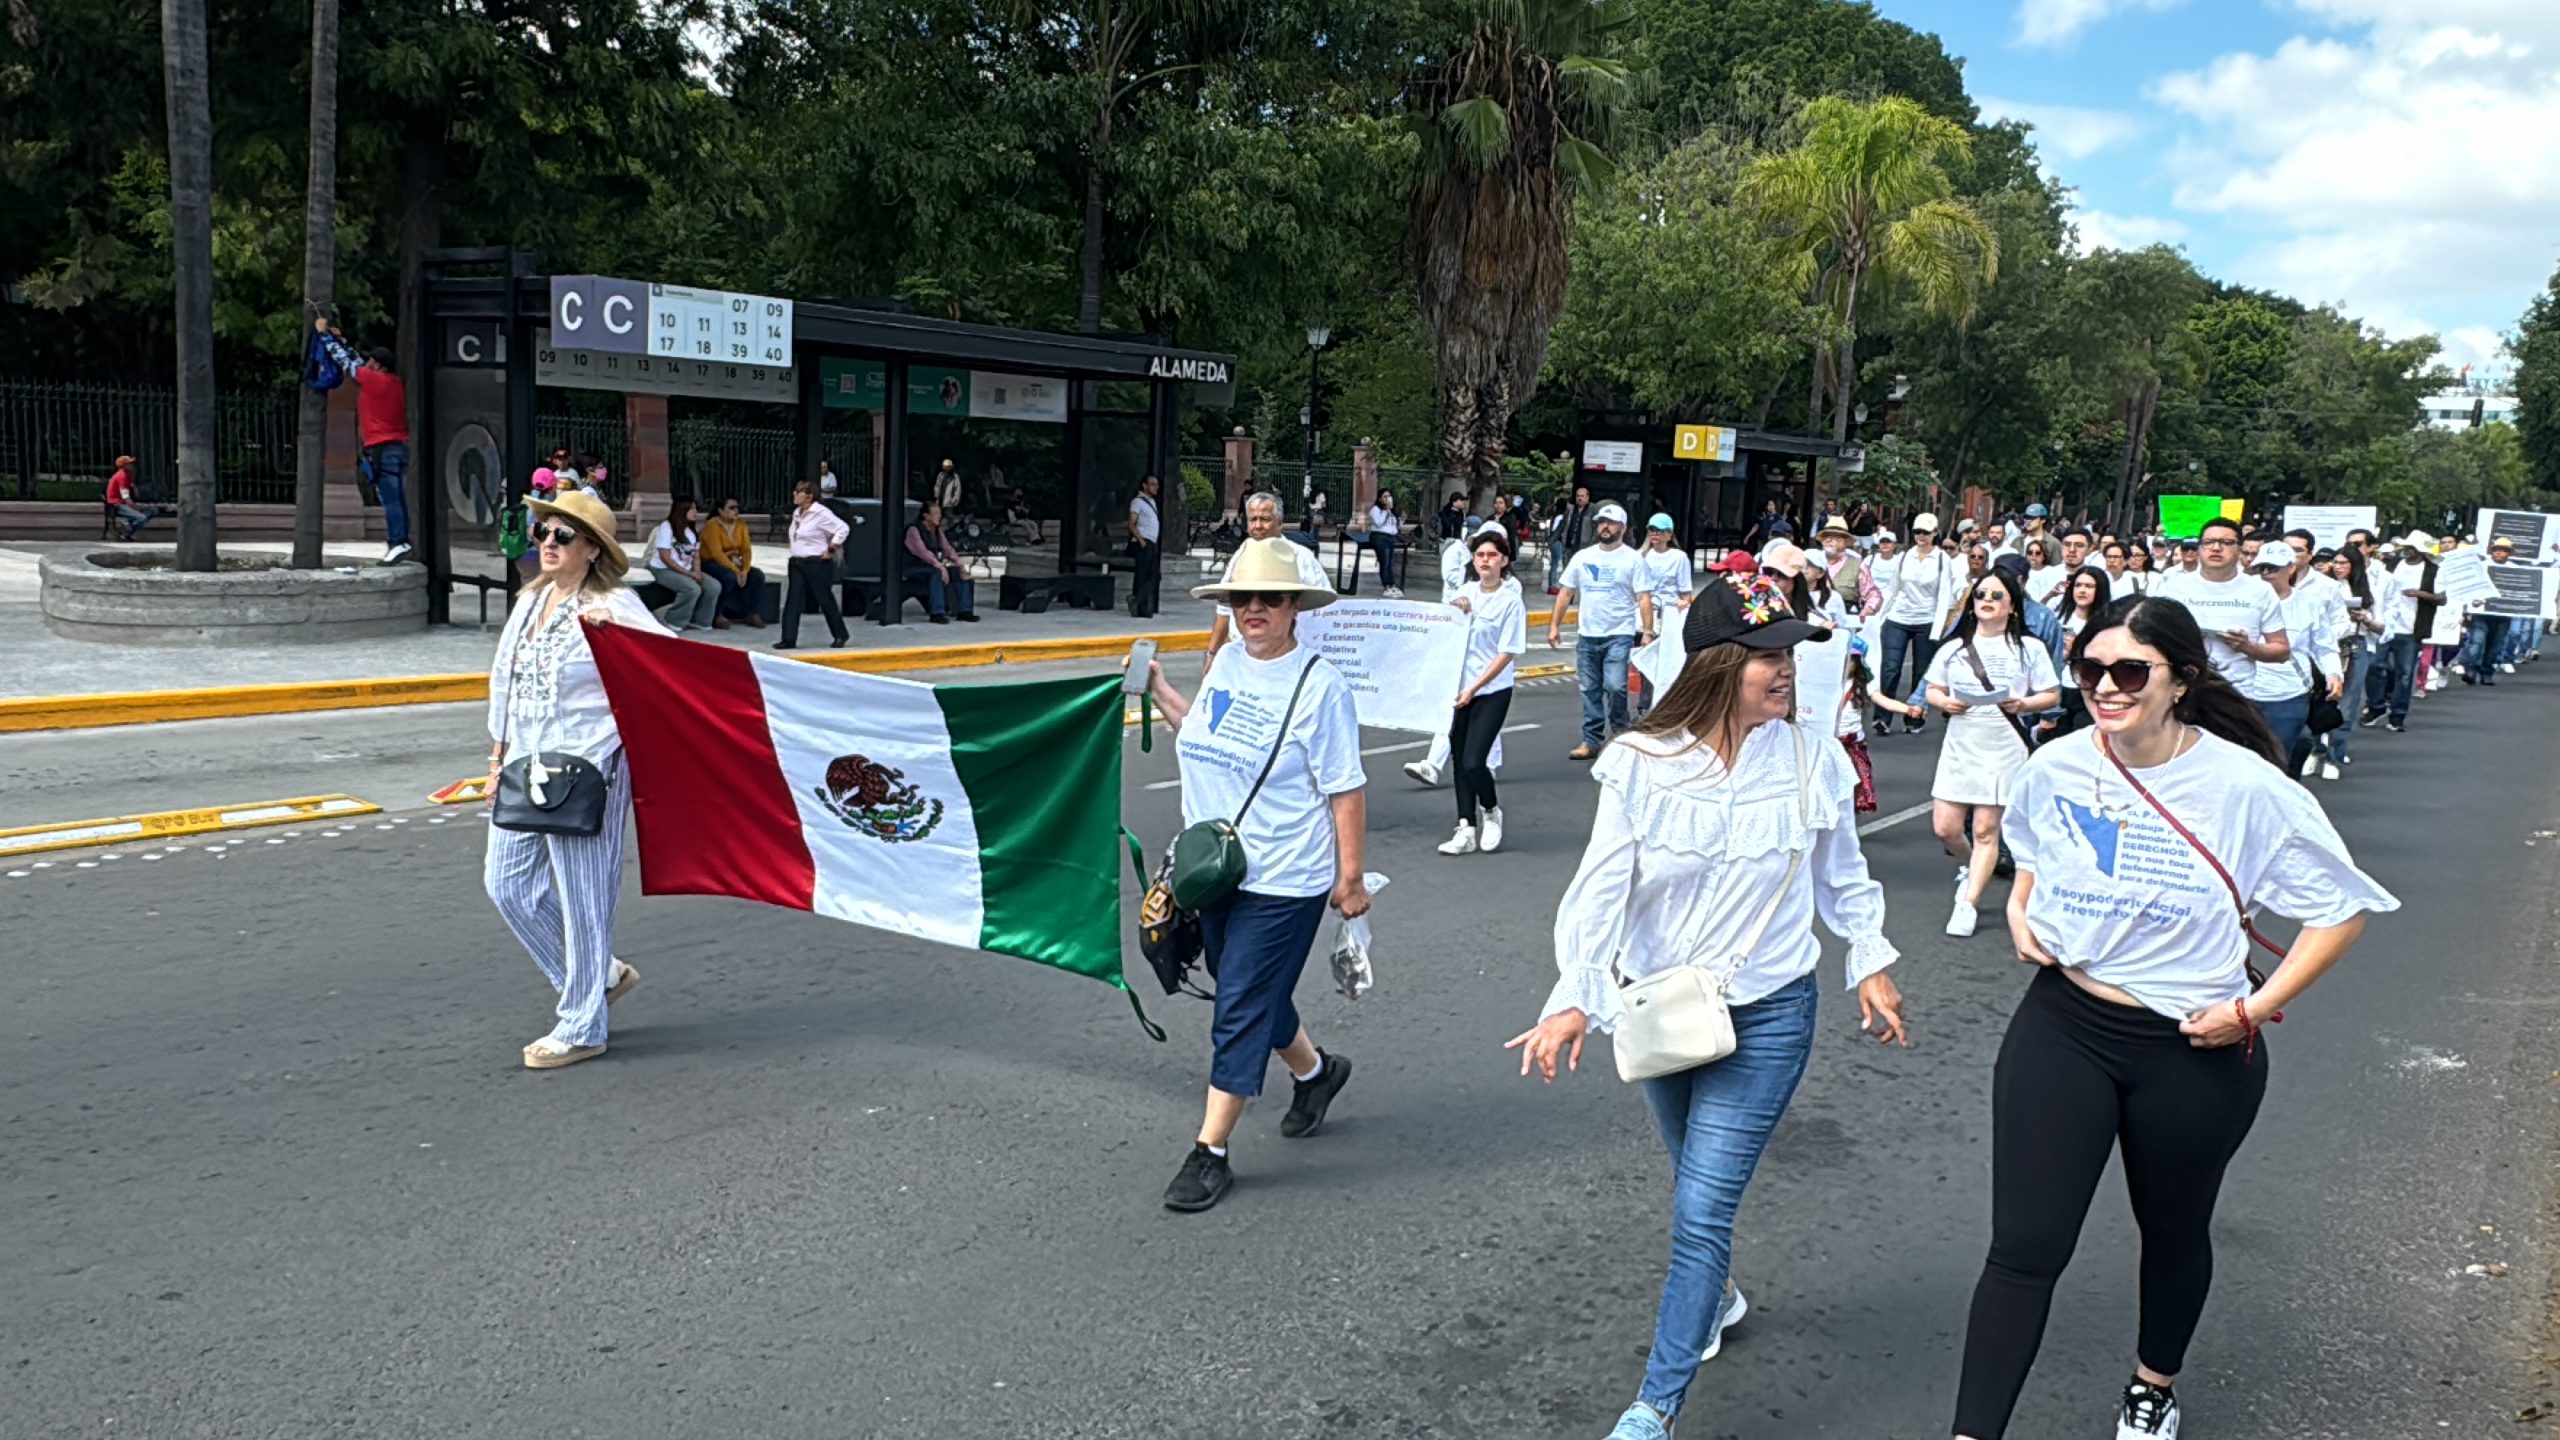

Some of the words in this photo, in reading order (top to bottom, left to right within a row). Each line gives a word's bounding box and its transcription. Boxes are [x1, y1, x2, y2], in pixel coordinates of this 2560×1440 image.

[560, 291, 583, 331] C
[603, 295, 634, 334] C
[732, 299, 748, 313] 07
[767, 303, 783, 317] 09
[660, 313, 676, 328] 10
[698, 317, 711, 332] 11
[733, 322, 747, 336] 13
[767, 325, 782, 340] 14
[458, 334, 481, 362] C
[660, 337, 674, 352] 17
[697, 341, 711, 355] 18
[731, 343, 748, 358] 39
[765, 346, 782, 361] 40
[539, 350, 556, 363] 09
[573, 353, 588, 366] 10
[607, 356, 618, 369] 11
[637, 359, 650, 372] 13
[667, 362, 680, 374] 14
[697, 365, 709, 377] 17
[725, 366, 737, 378] 18
[752, 369, 765, 381] 39
[778, 371, 792, 383] 40
[1149, 356, 1228, 383] ALAMEDA
[1683, 432, 1698, 450] D
[1708, 434, 1717, 452] D
[1371, 609, 1382, 617] en
[1383, 608, 1391, 617] la
[1393, 610, 1424, 620] carrera
[1425, 612, 1453, 623] judicial
[1343, 621, 1380, 631] garantiza
[1382, 622, 1398, 631] una
[1399, 623, 1429, 634] justicia
[1322, 633, 1365, 642] Excelente
[1322, 645, 1357, 655] Objetiva
[2127, 822, 2165, 833] rabaja
[2121, 852, 2142, 863] Hoy
[2145, 856, 2165, 866] nos
[2169, 859, 2195, 870] toca
[2118, 874, 2143, 883] para
[2119, 863, 2190, 880] defendernos
